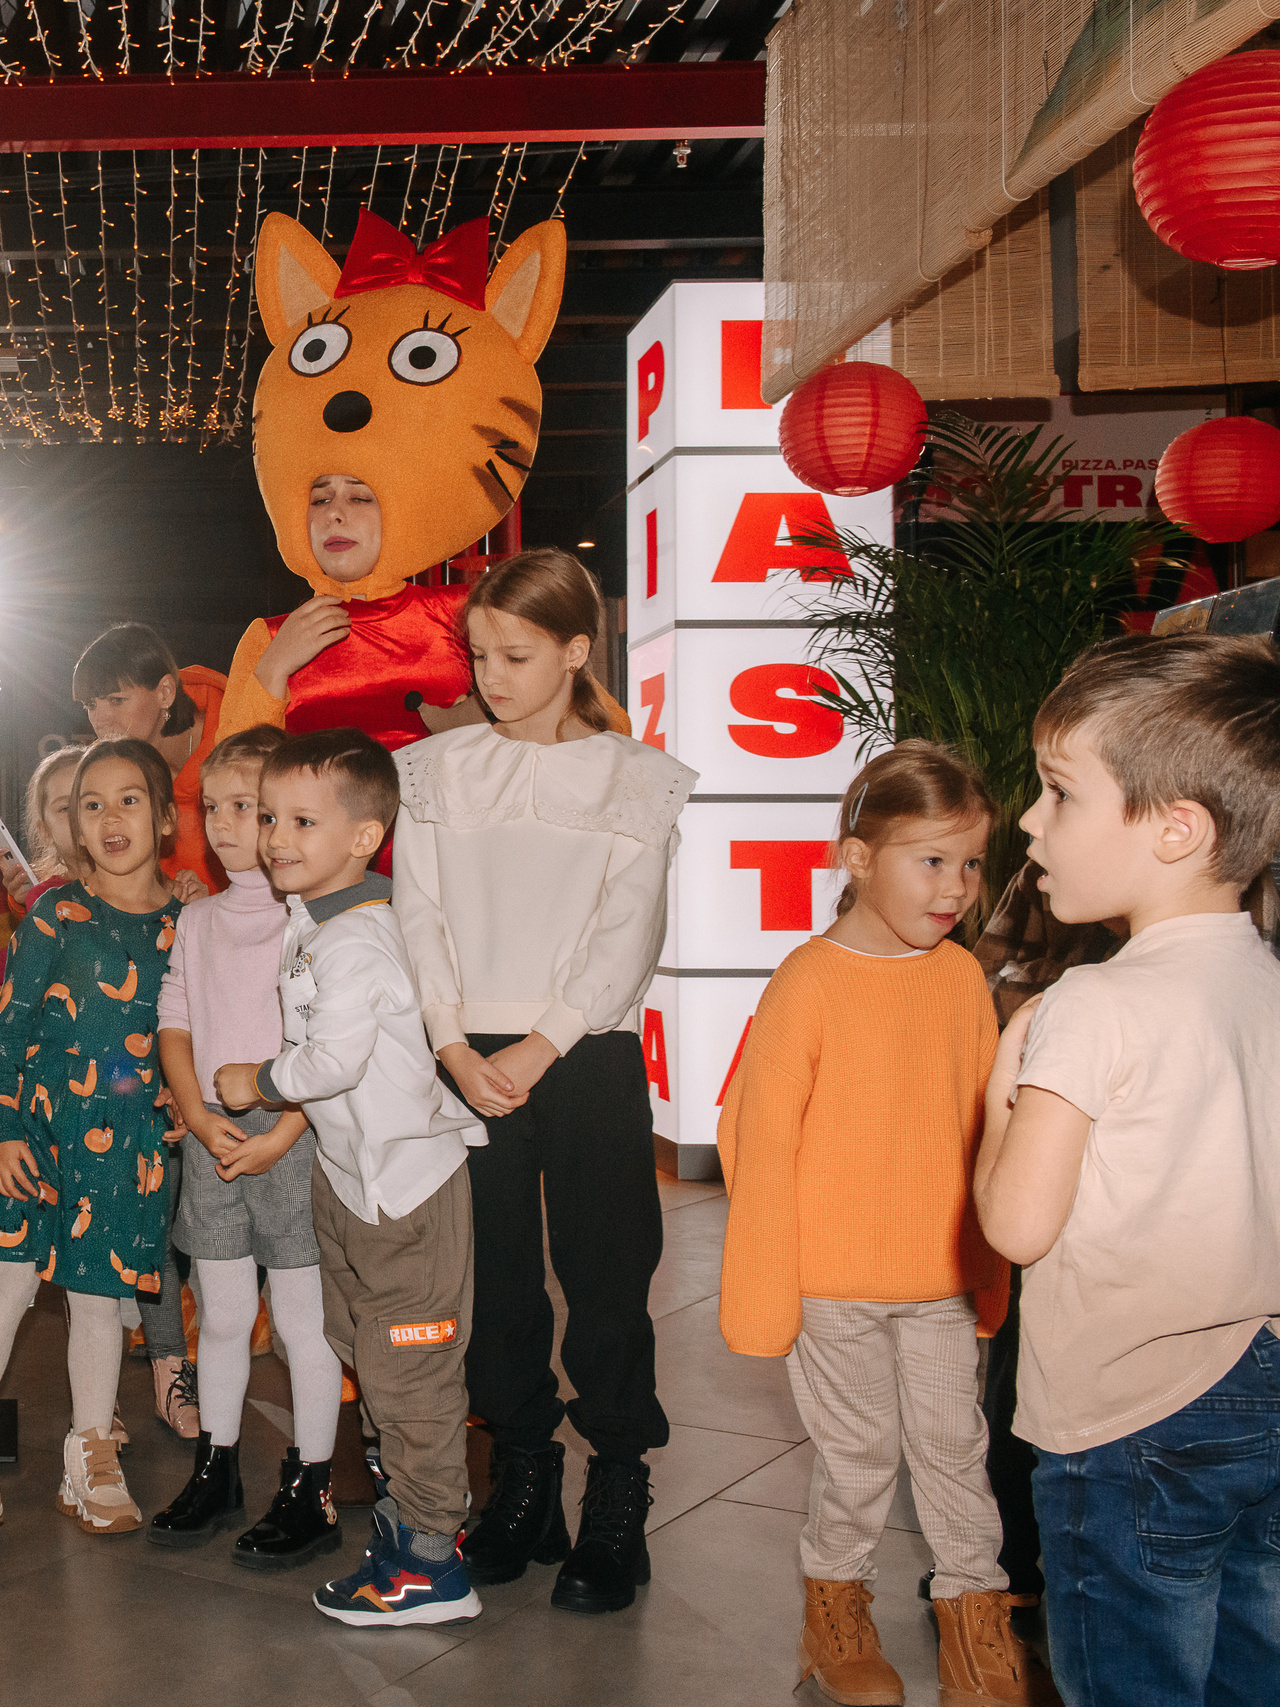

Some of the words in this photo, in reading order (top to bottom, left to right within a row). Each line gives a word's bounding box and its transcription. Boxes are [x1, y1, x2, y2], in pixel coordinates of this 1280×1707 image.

[1061, 459, 1160, 471] PIZZA.PAS
[637, 339, 670, 1103] PIZA
[710, 319, 856, 1107] PAST
[389, 1325, 440, 1343] RACE
